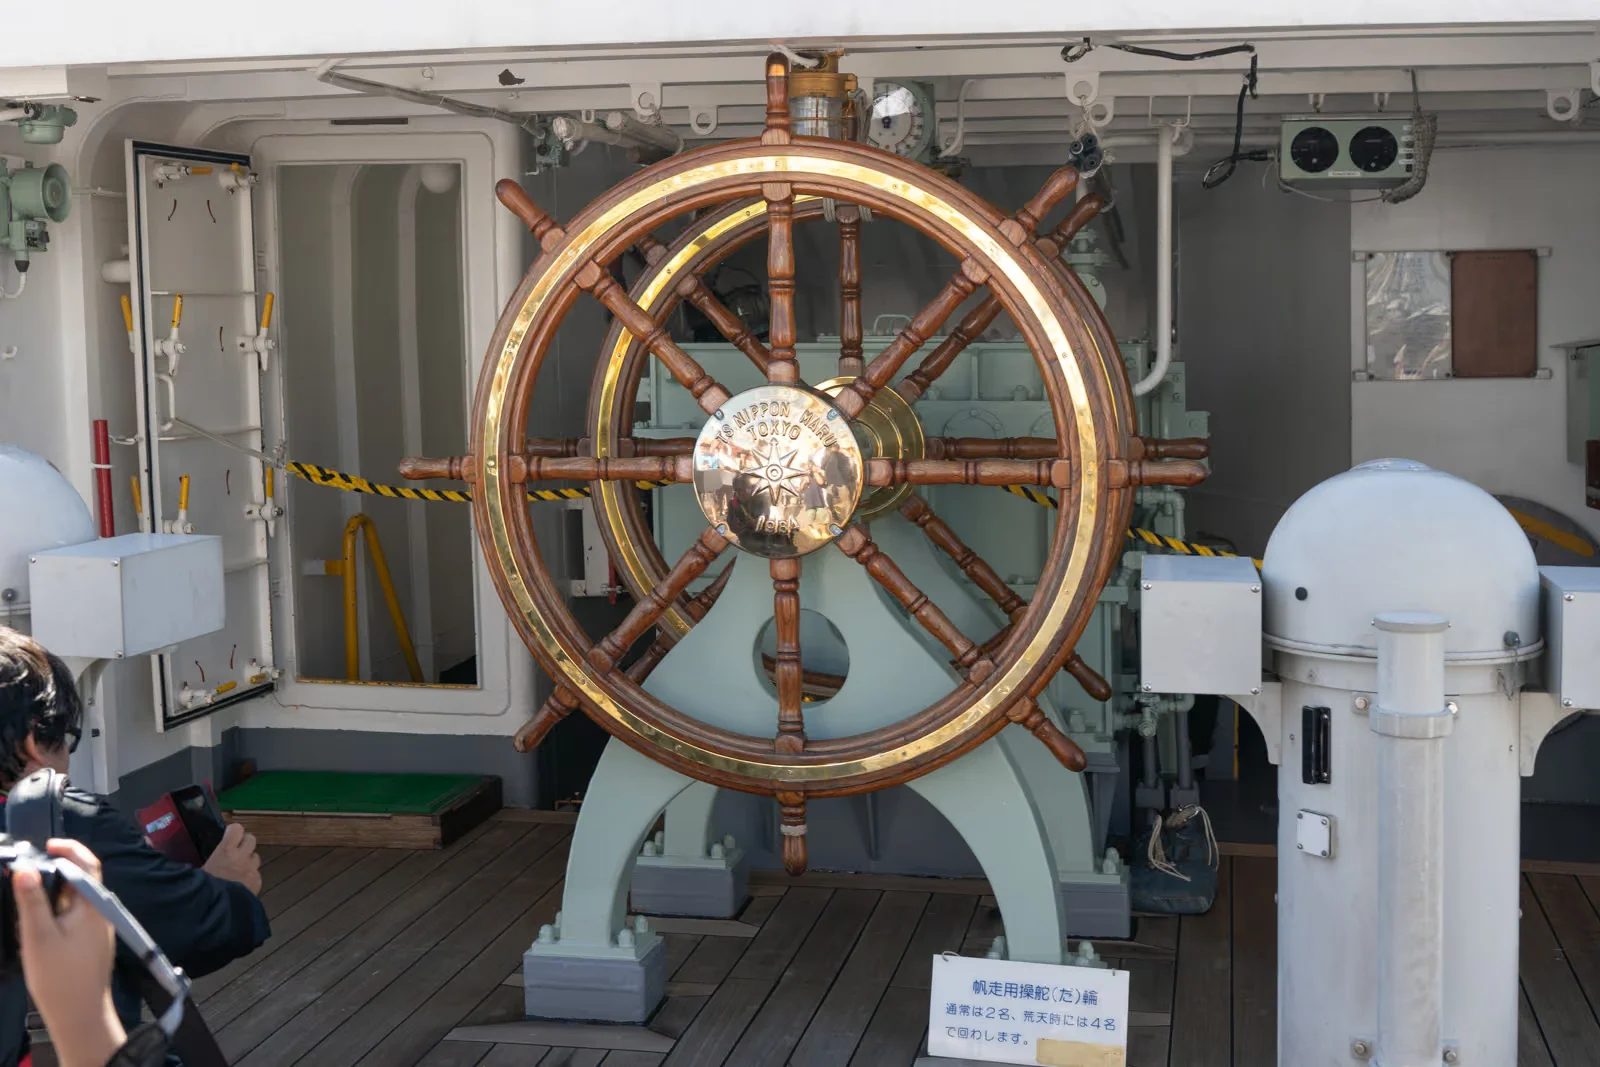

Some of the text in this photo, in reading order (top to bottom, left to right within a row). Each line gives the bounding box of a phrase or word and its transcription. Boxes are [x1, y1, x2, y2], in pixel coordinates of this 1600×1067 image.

[716, 401, 838, 447] TS NIPPON MARU
[747, 420, 800, 440] TOKYO
[945, 1003, 1116, 1031] 通常は2名、荒天時には4名
[945, 1026, 1029, 1046] で回わします。
